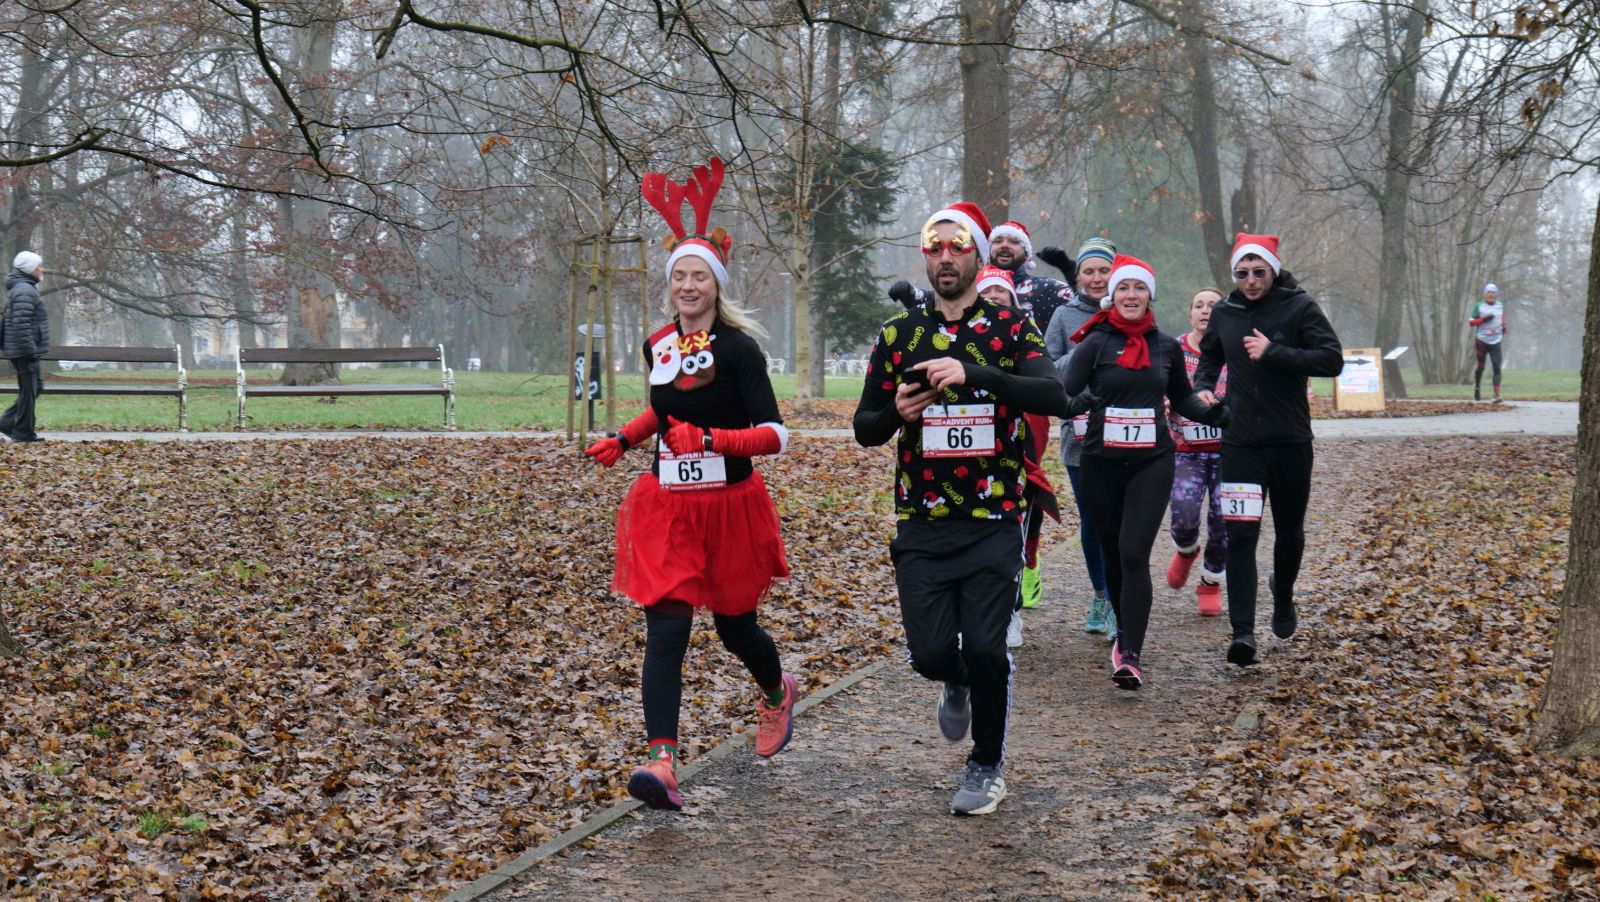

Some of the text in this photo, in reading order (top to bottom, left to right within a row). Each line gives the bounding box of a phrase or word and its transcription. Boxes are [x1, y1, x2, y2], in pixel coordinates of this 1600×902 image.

[966, 342, 988, 367] GRINCH
[947, 427, 973, 449] 66
[1123, 426, 1141, 441] 17
[1194, 426, 1218, 439] 110
[678, 460, 703, 482] 65
[1230, 500, 1245, 514] 31
